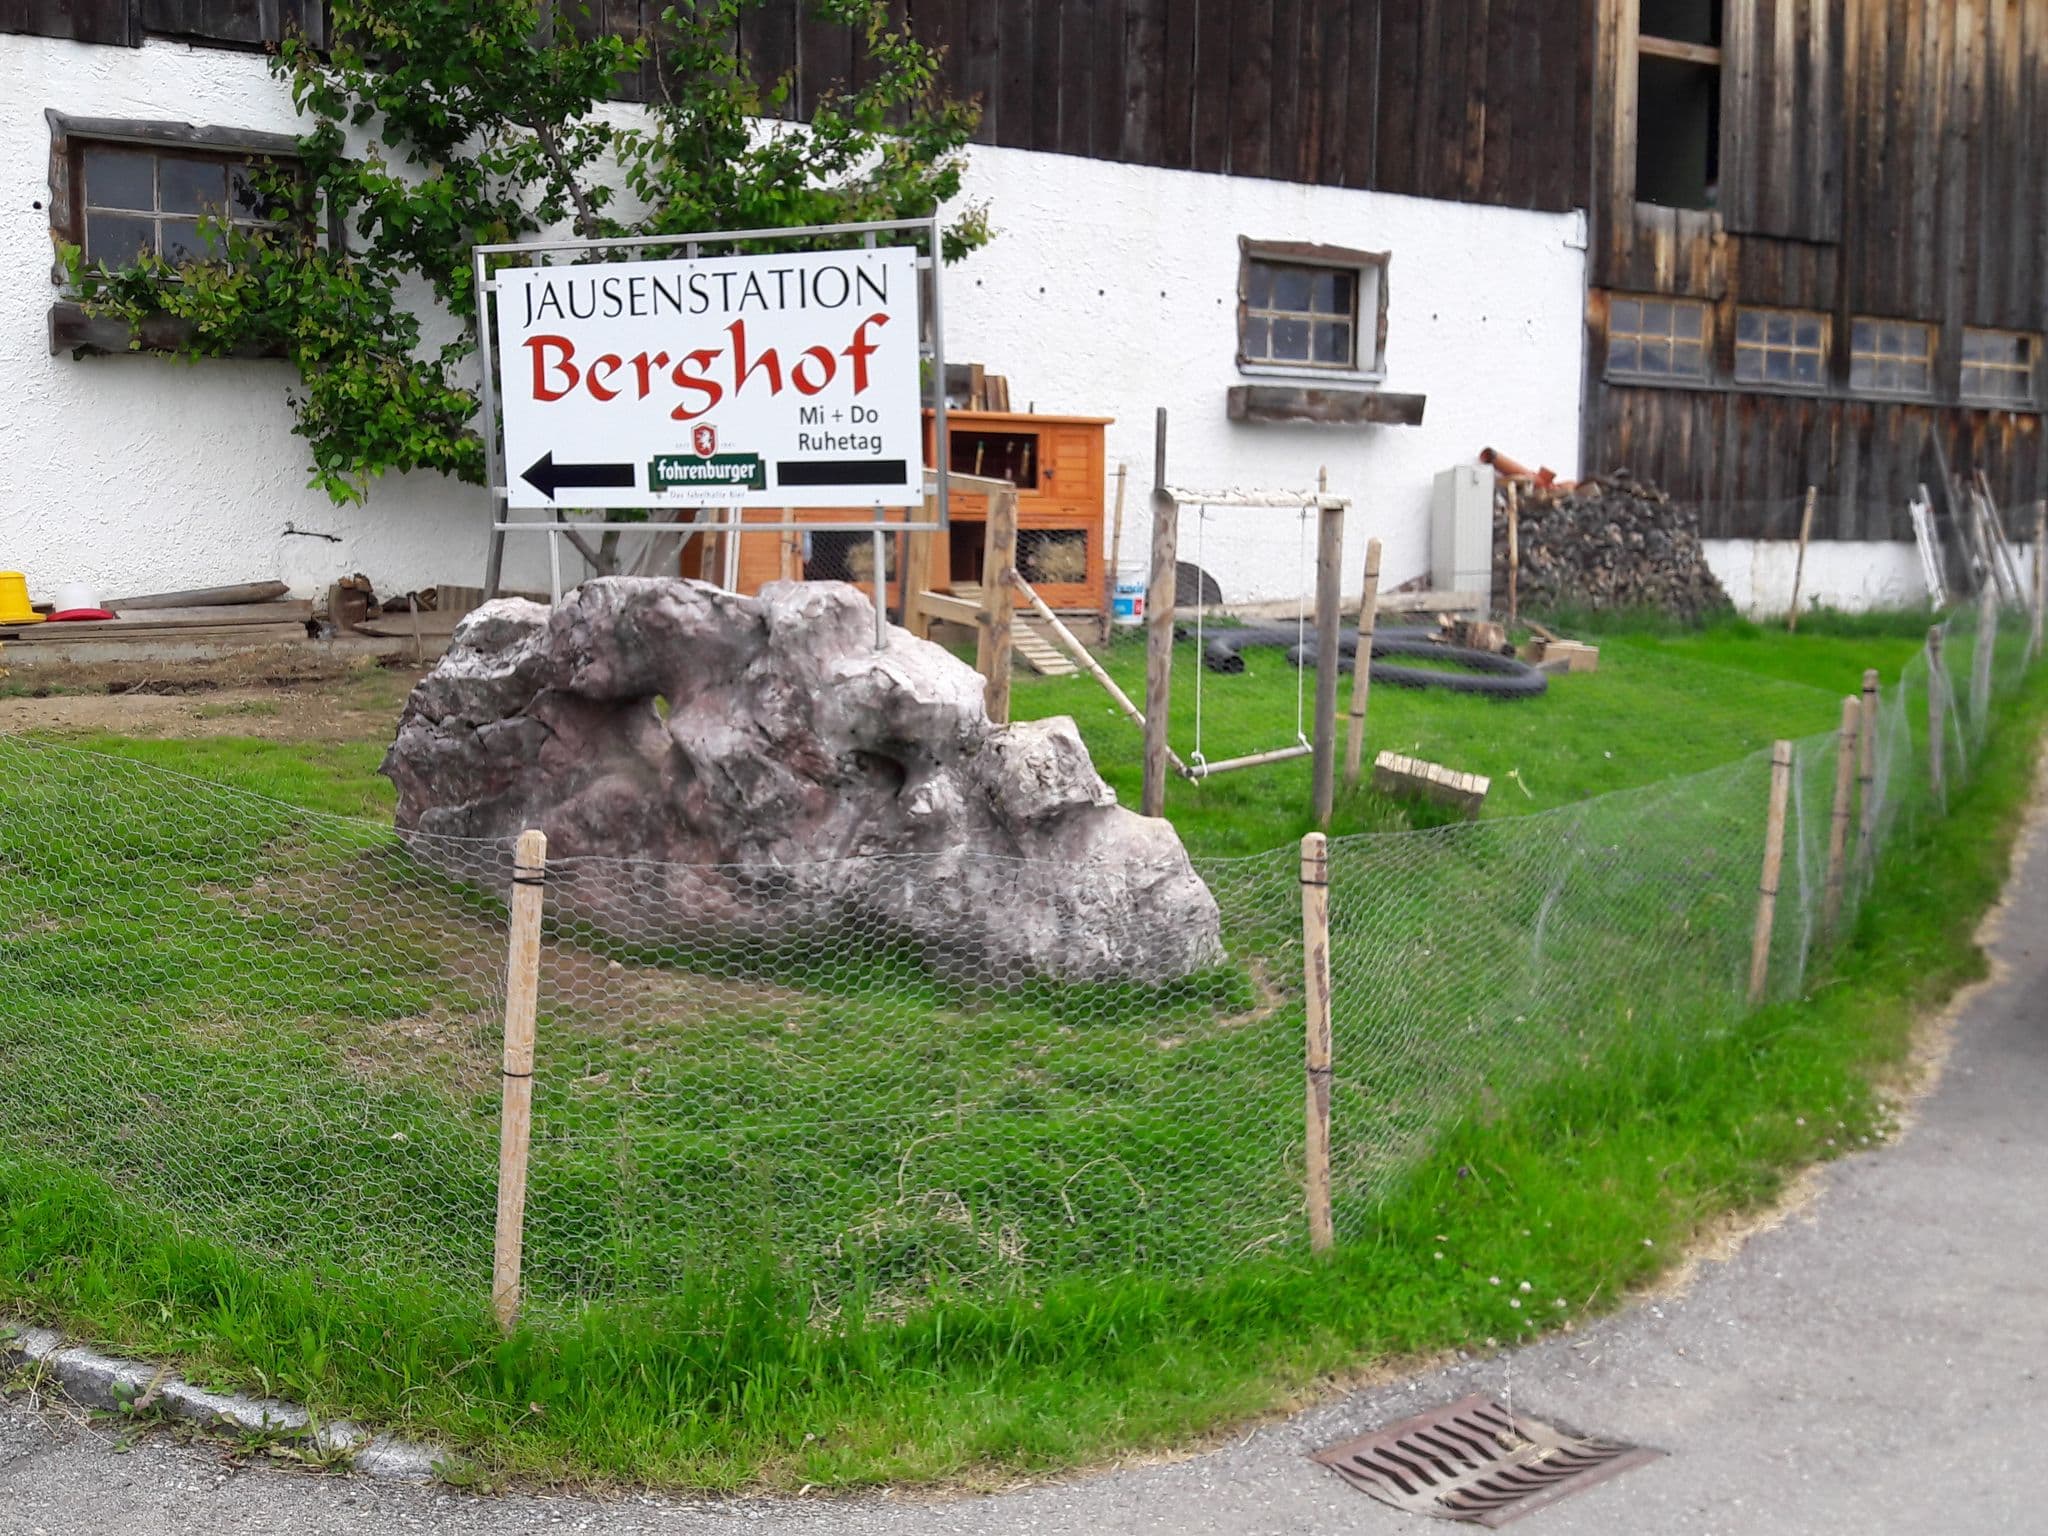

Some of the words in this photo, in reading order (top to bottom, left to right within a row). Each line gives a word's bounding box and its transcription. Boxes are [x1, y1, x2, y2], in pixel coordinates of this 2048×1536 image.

[523, 263, 888, 328] JAUSENSTATION
[522, 313, 891, 421] Berghof
[800, 406, 824, 425] Mi
[831, 409, 844, 422] +
[851, 405, 878, 424] Do
[798, 431, 882, 455] Ruhetag
